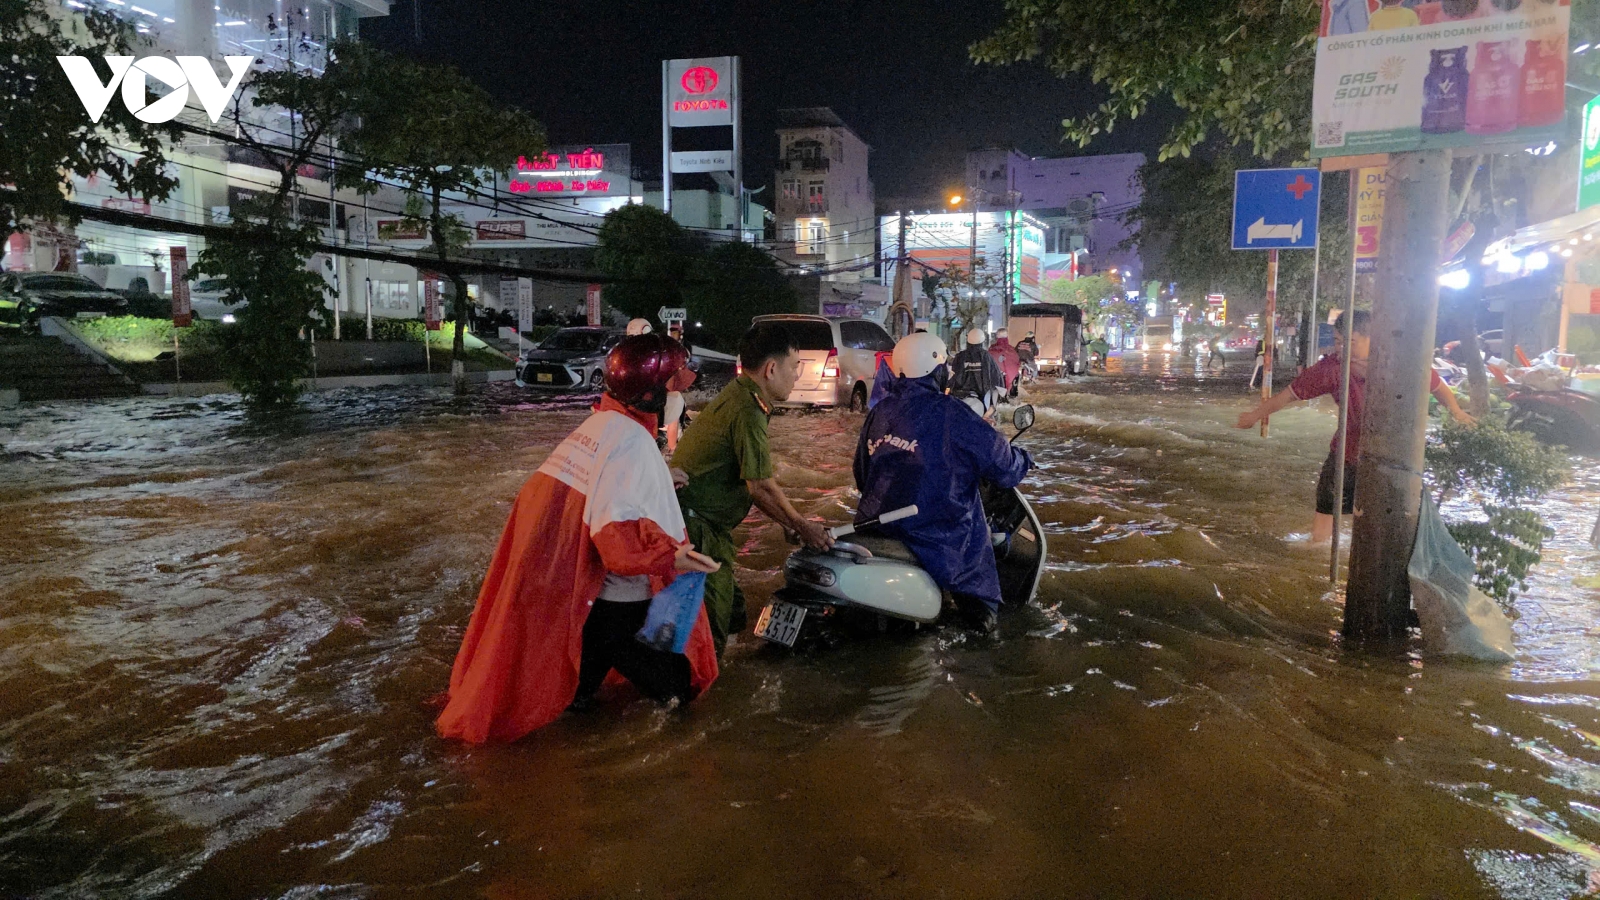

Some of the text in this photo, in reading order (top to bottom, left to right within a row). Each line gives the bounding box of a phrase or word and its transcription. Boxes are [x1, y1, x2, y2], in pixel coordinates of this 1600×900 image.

[1328, 41, 1354, 51] CÔNG
[1357, 39, 1367, 47] TY
[1415, 30, 1440, 40] KINH
[1443, 26, 1481, 38] DOANH
[1484, 22, 1502, 33] KHÍ
[1534, 16, 1556, 26] NAM
[1339, 72, 1378, 86] GAS
[1334, 83, 1398, 100] SOUTH
[673, 100, 729, 112] TOYOTA
[567, 147, 603, 169] TIẾN
[680, 158, 697, 166] Toyota
[480, 224, 521, 232] SURE
